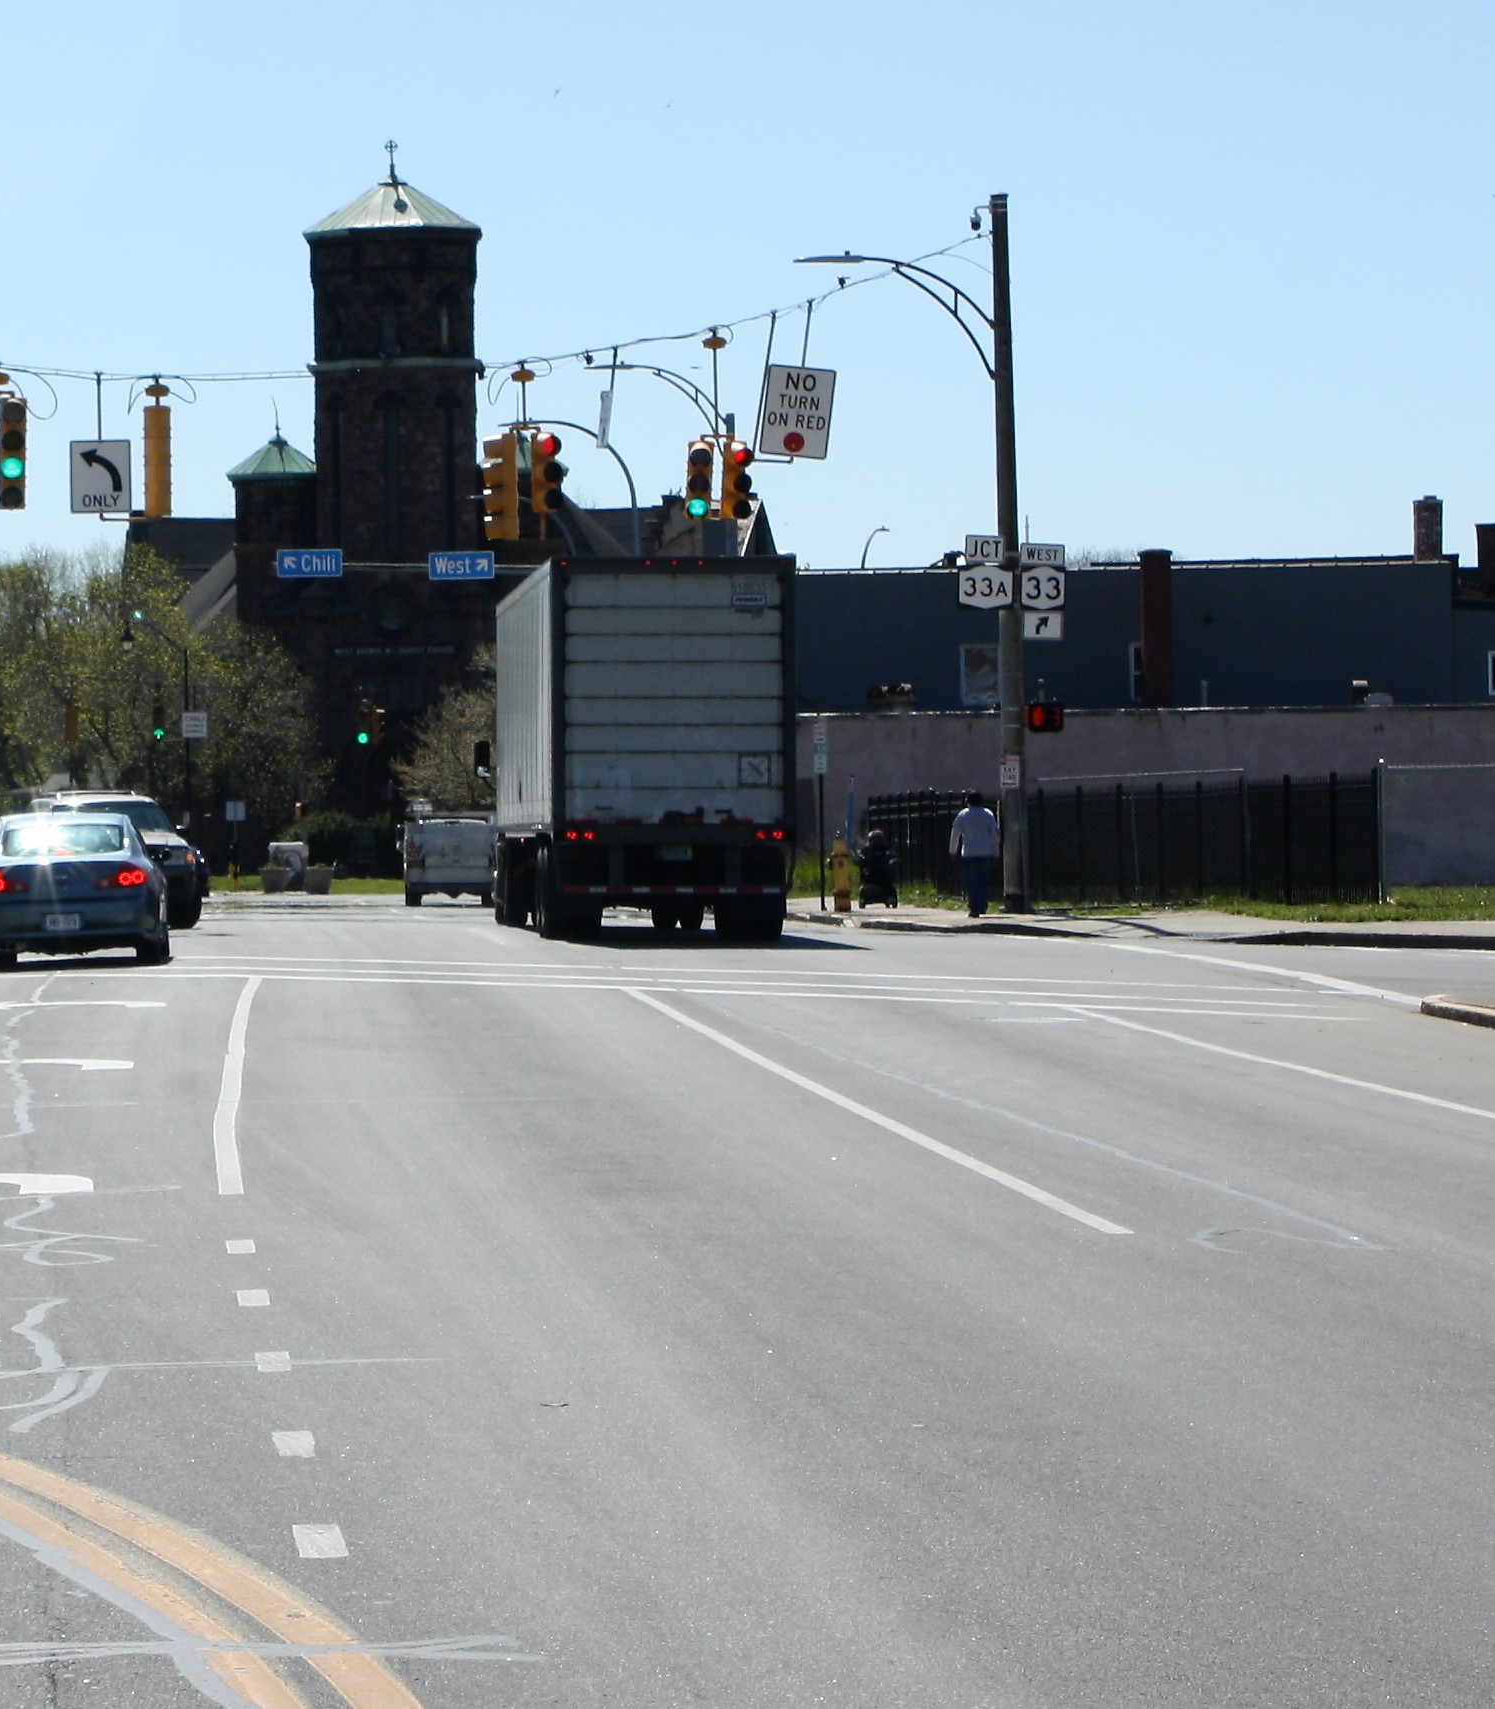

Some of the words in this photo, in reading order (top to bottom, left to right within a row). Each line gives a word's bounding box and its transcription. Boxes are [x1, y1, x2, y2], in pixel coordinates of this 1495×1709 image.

[786, 372, 816, 392] NO
[780, 394, 820, 411] TURN
[767, 411, 788, 427] ON
[795, 414, 826, 431] RED
[82, 494, 120, 508] ONLY
[969, 540, 1002, 559] JCT
[1026, 548, 1059, 561] WEST
[301, 554, 336, 573] Chili
[434, 557, 471, 575] West
[964, 577, 1008, 597] 33A
[1026, 576, 1061, 600] 33
